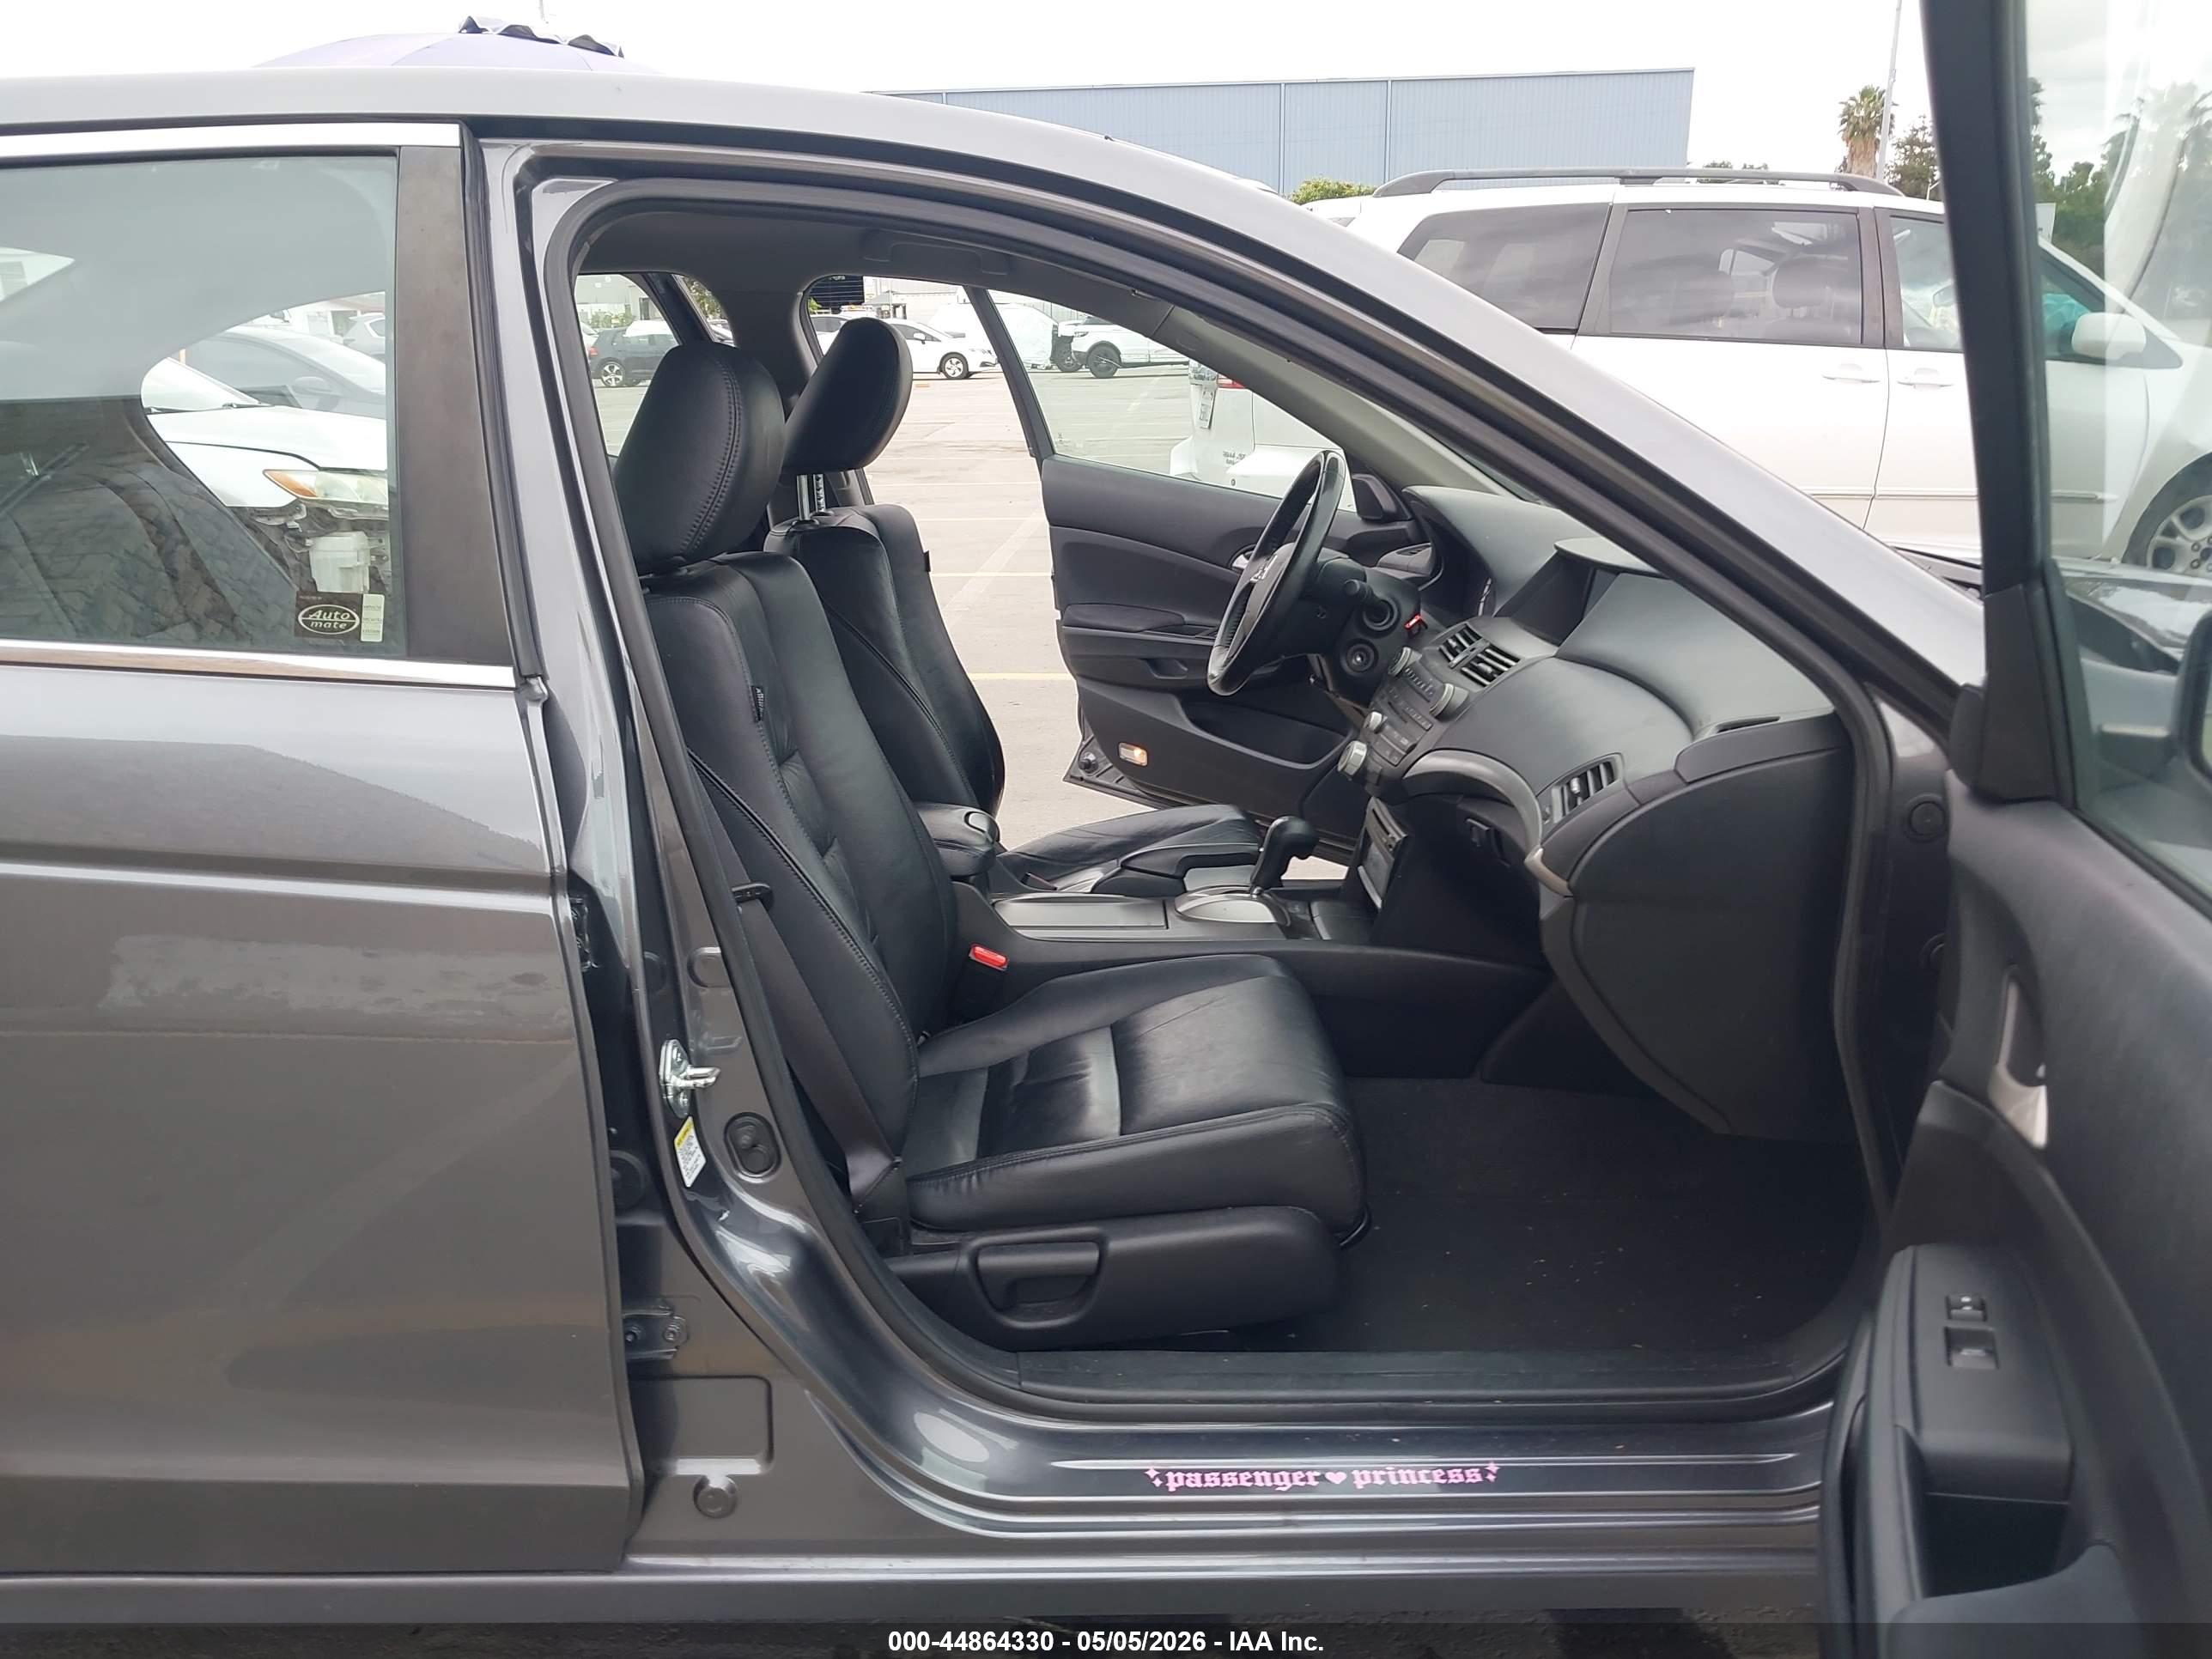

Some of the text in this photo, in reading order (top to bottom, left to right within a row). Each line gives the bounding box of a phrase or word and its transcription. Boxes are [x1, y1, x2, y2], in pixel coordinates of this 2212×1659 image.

[308, 610, 350, 620] Auto
[310, 621, 347, 629] mate
[1164, 1466, 1484, 1492] passenger princess
